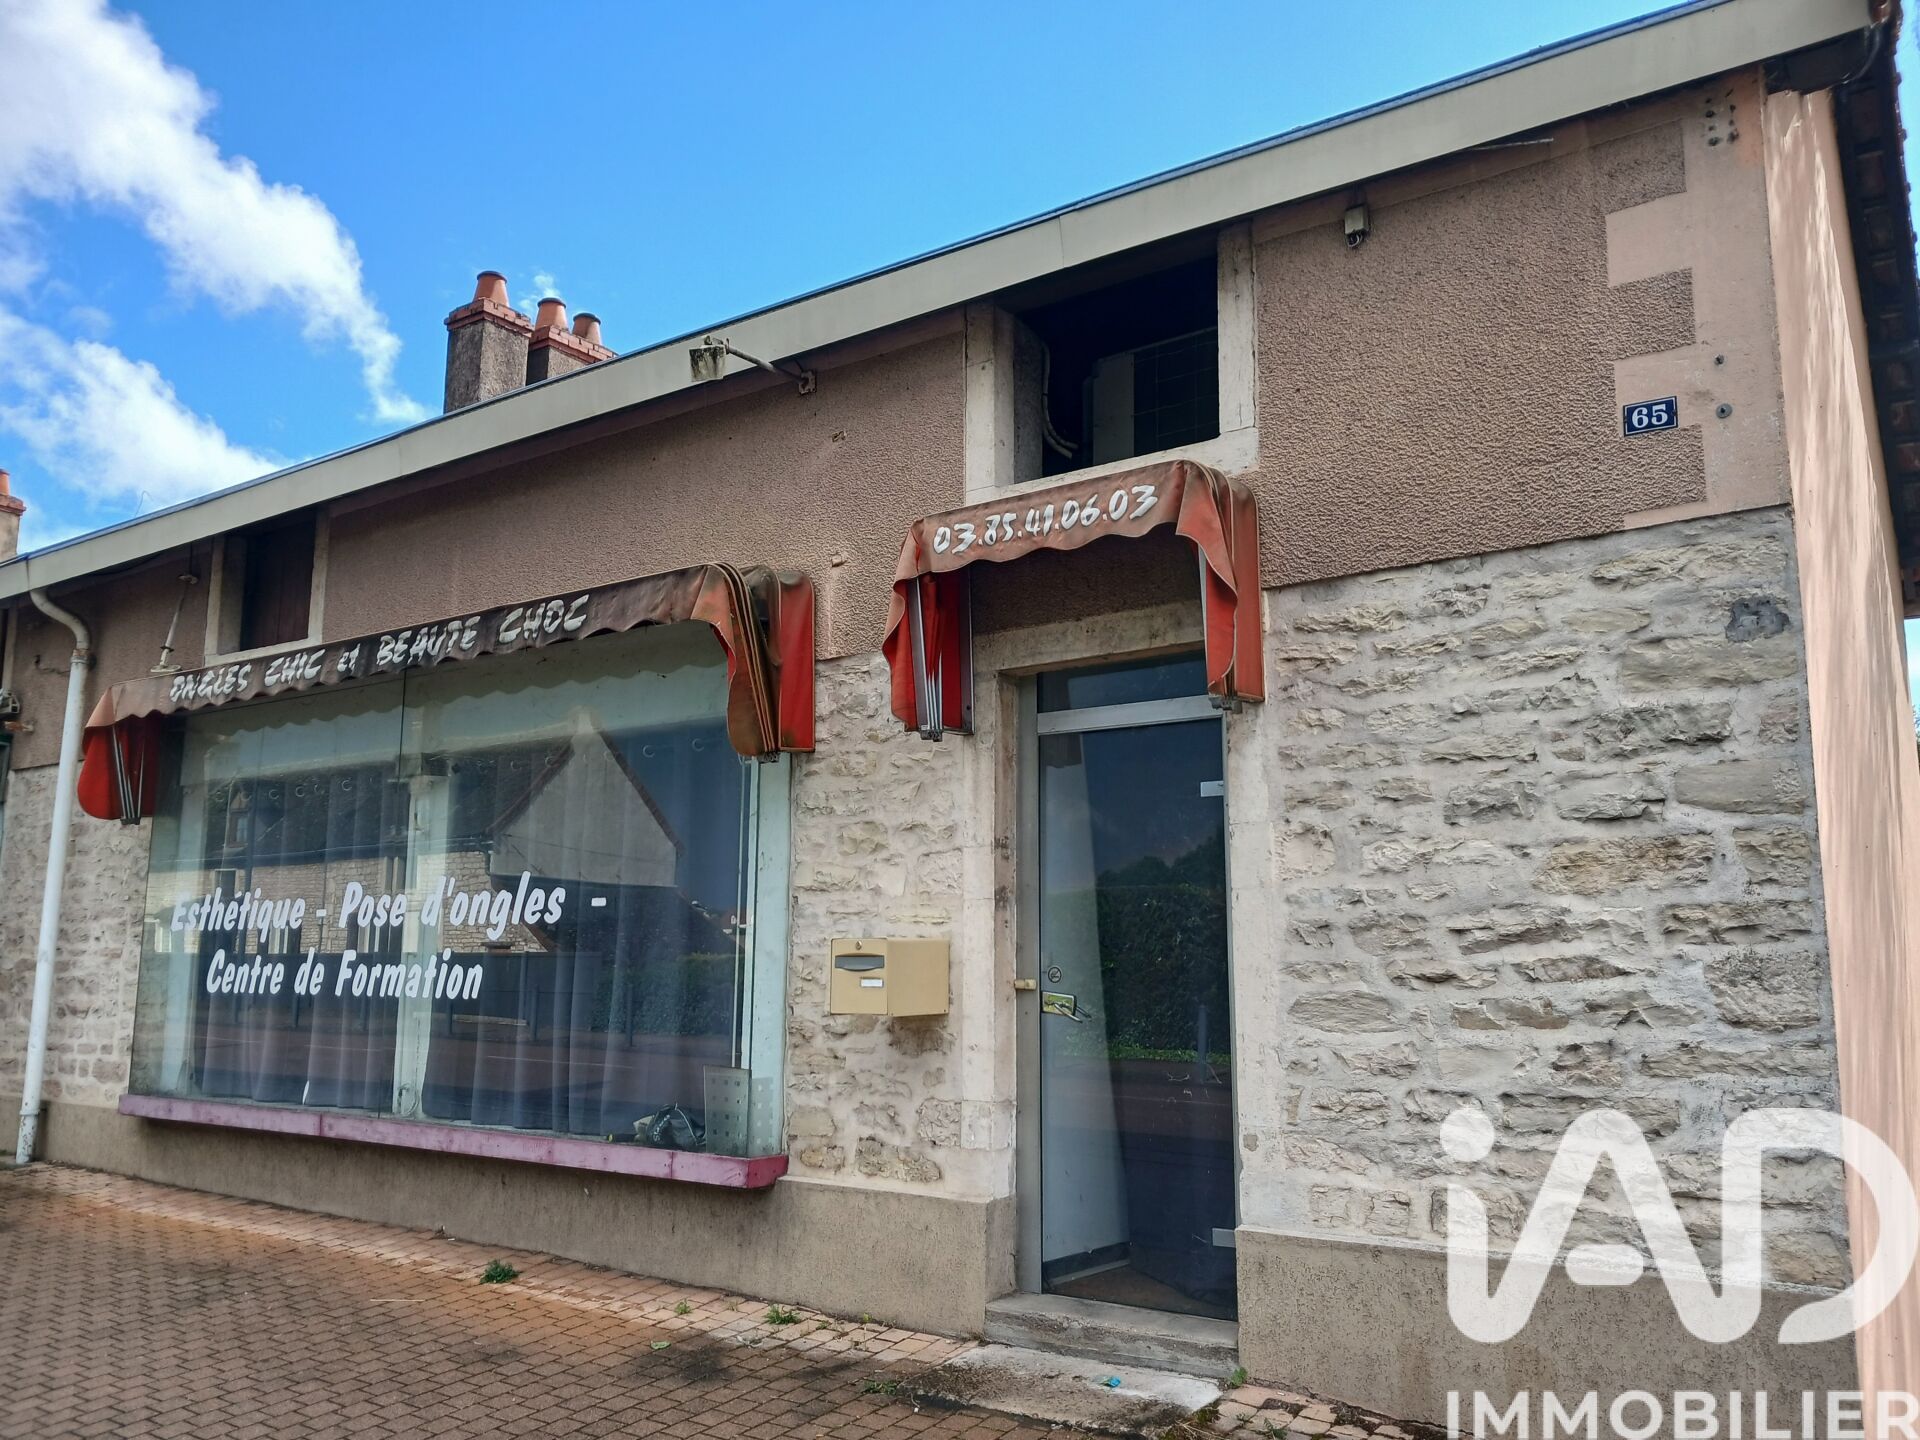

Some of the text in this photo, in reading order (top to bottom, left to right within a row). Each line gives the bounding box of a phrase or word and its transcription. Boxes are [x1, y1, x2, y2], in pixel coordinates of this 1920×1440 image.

[1631, 403, 1669, 428] 65
[169, 594, 590, 703] ONGLES CHIC et BEAUTE CHOC
[171, 887, 306, 943] Esthétique
[338, 881, 408, 929] Pose
[421, 870, 566, 941] d'ongles
[206, 946, 484, 1000] Centre de Formation
